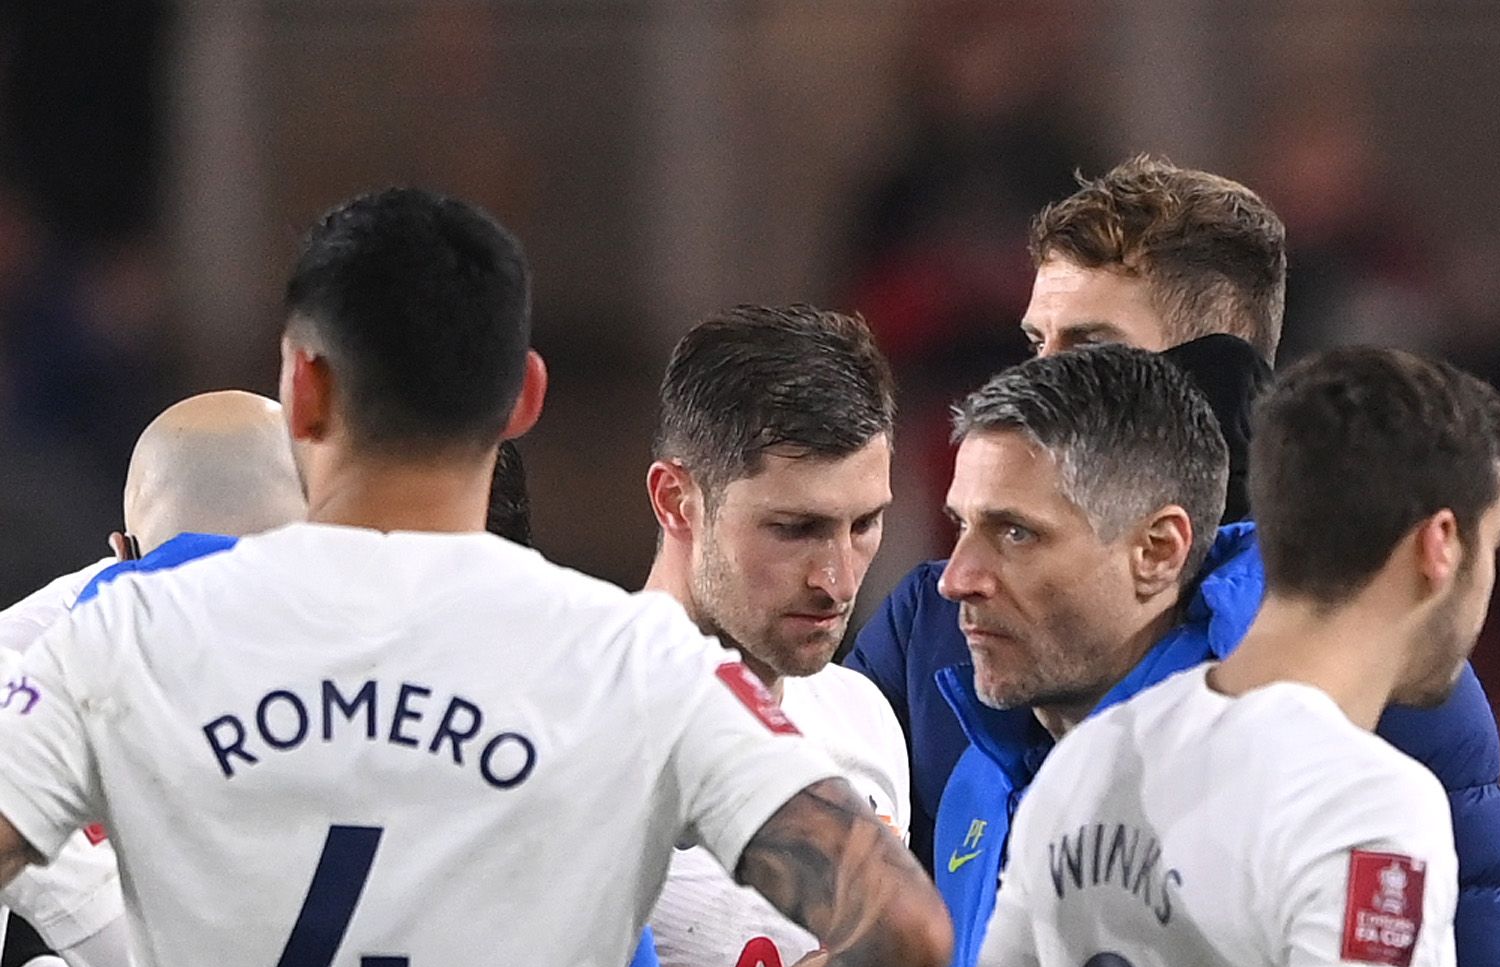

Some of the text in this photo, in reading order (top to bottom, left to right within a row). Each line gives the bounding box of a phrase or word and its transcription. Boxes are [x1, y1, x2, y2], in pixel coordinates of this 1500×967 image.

[202, 679, 537, 790] ROMERO
[963, 818, 988, 849] PF
[1049, 823, 1183, 927] WINKS
